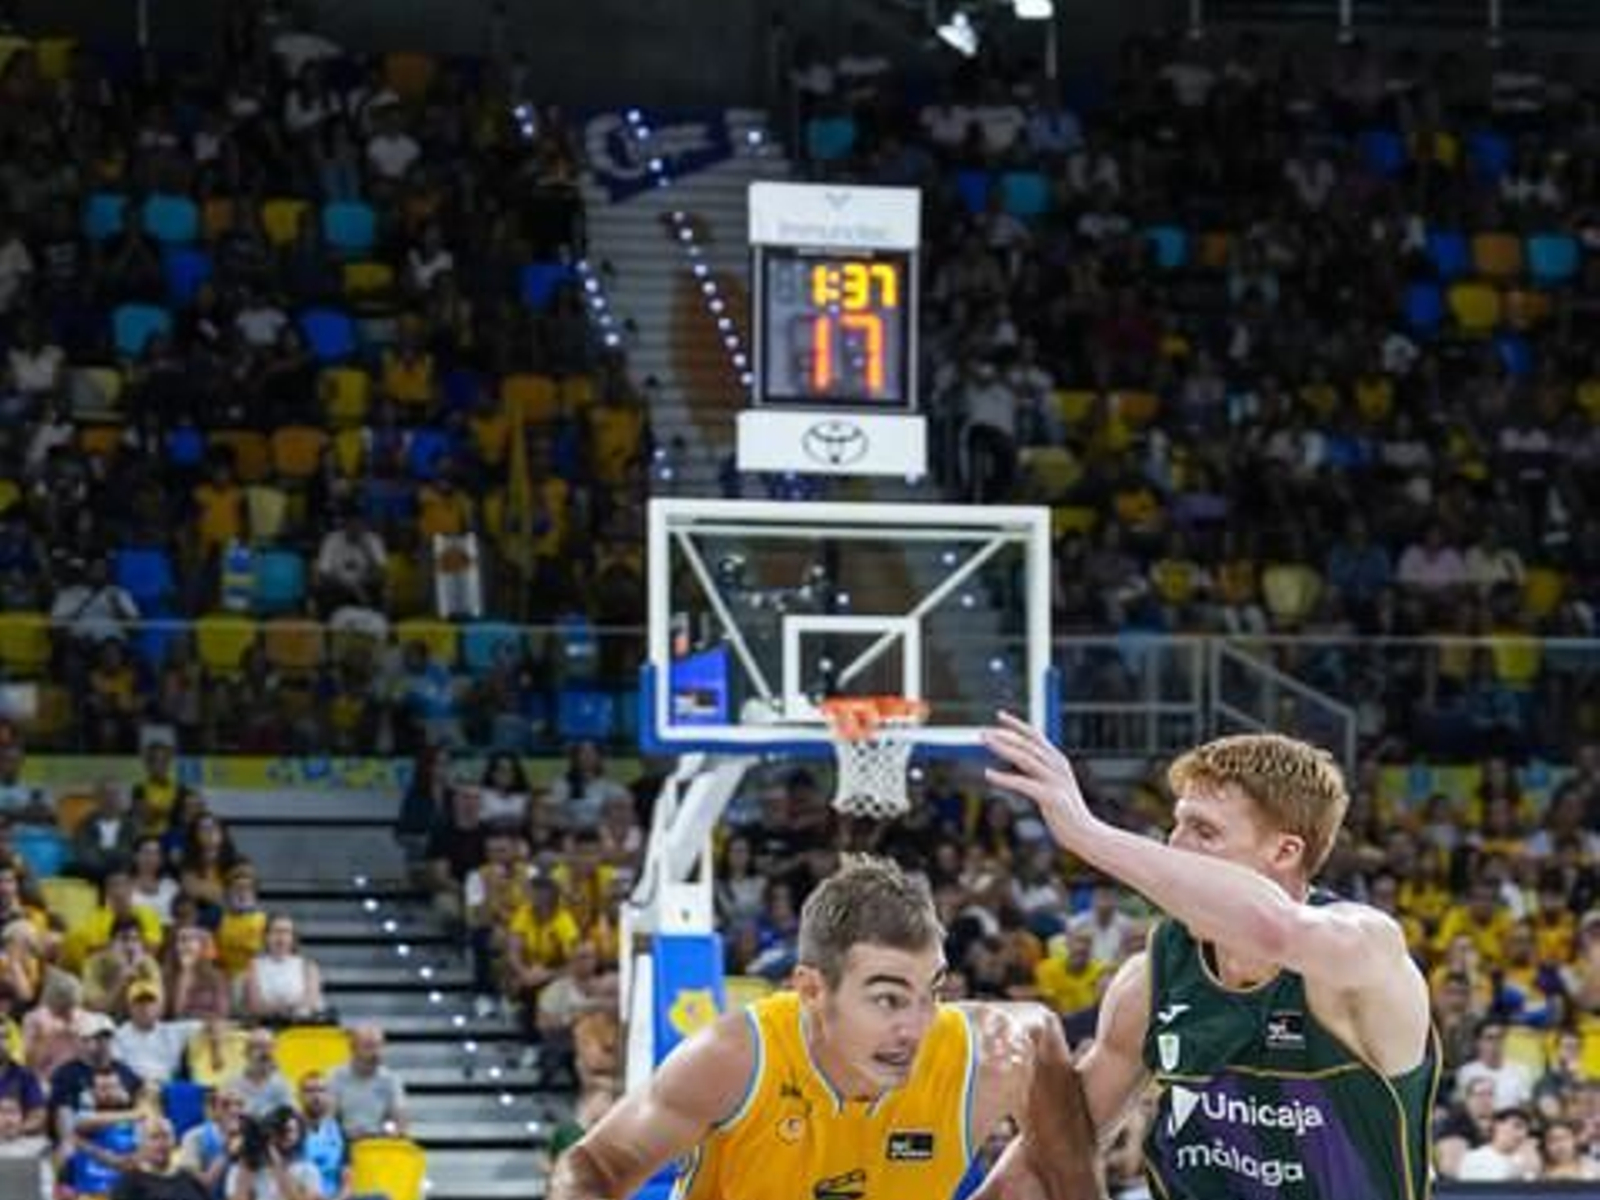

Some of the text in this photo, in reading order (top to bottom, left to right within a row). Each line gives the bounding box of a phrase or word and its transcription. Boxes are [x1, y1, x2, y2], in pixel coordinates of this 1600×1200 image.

[812, 263, 897, 309] 1:37
[813, 314, 884, 393] 17
[1202, 1091, 1325, 1135] Unicaja
